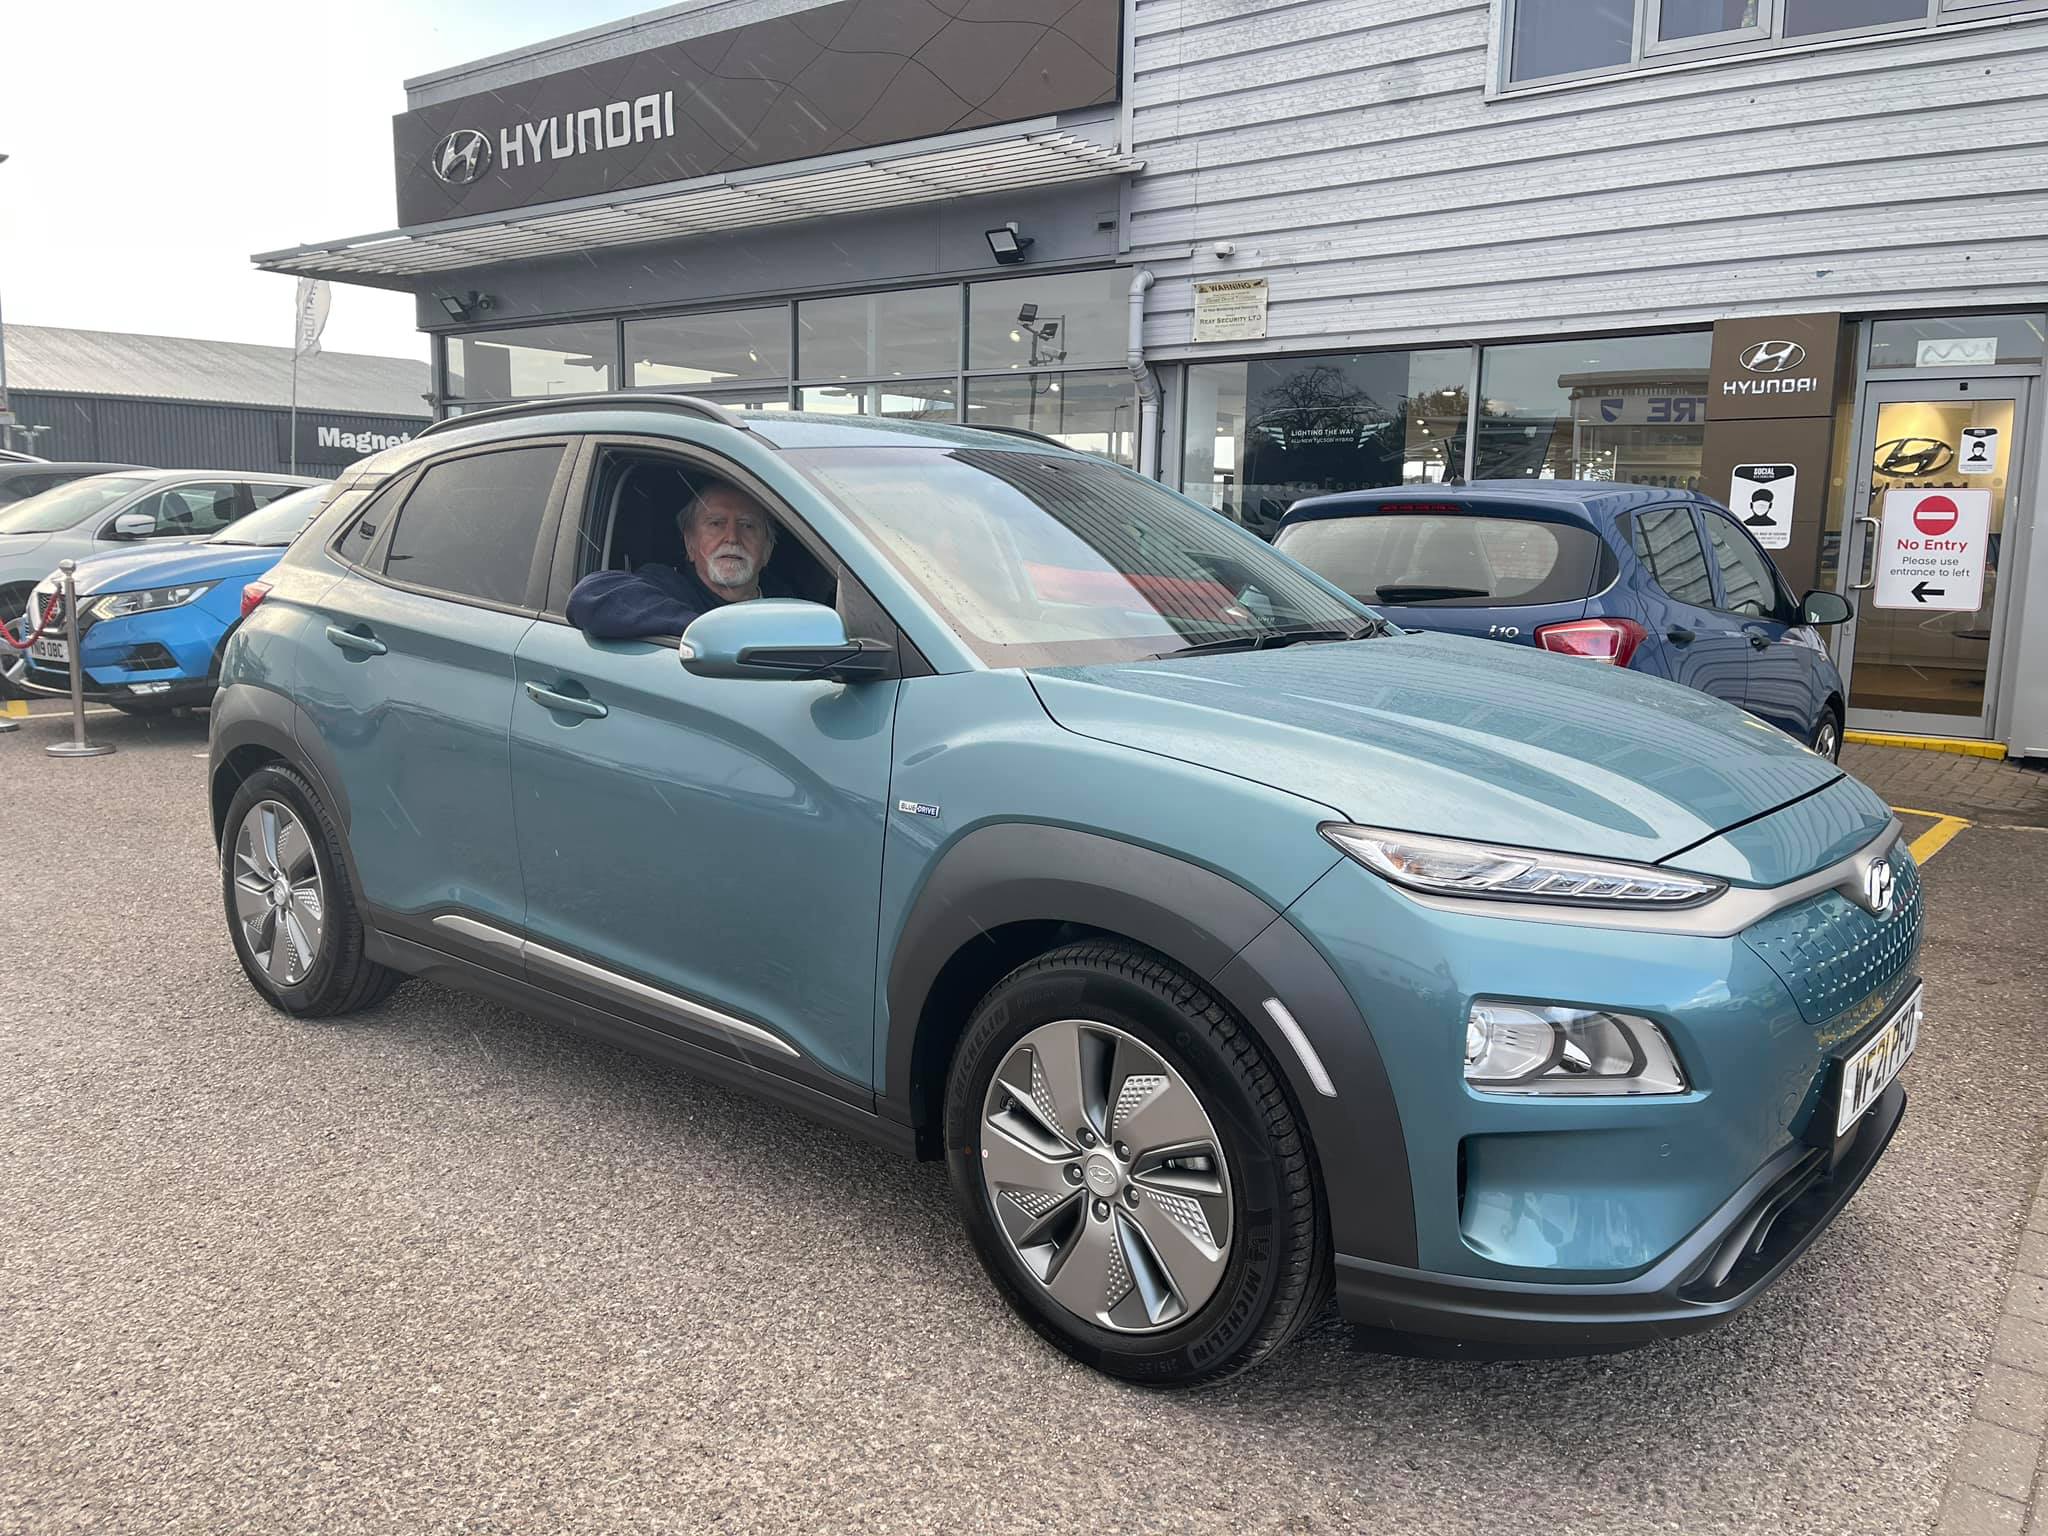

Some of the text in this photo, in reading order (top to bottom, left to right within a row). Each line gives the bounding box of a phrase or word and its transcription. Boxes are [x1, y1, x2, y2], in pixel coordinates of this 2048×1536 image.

[500, 90, 675, 169] HYUNDAI
[1208, 282, 1252, 292] WARNING
[1216, 316, 1247, 324] SECURITY
[1723, 378, 1817, 395] HYUNDAI
[1291, 429, 1323, 437] LIGHTING
[1324, 428, 1337, 436] THE
[317, 426, 411, 453] Magnet
[1753, 467, 1775, 475] SOCIAL
[1897, 539, 1968, 553] No Entry
[1902, 556, 1959, 566] Please use
[1890, 568, 1970, 577] entrance to left
[1489, 625, 1520, 638] i10
[917, 804, 937, 816] DRIVE
[1852, 1033, 1889, 1113] WF21
[1192, 1267, 1263, 1362] MICHELIN
